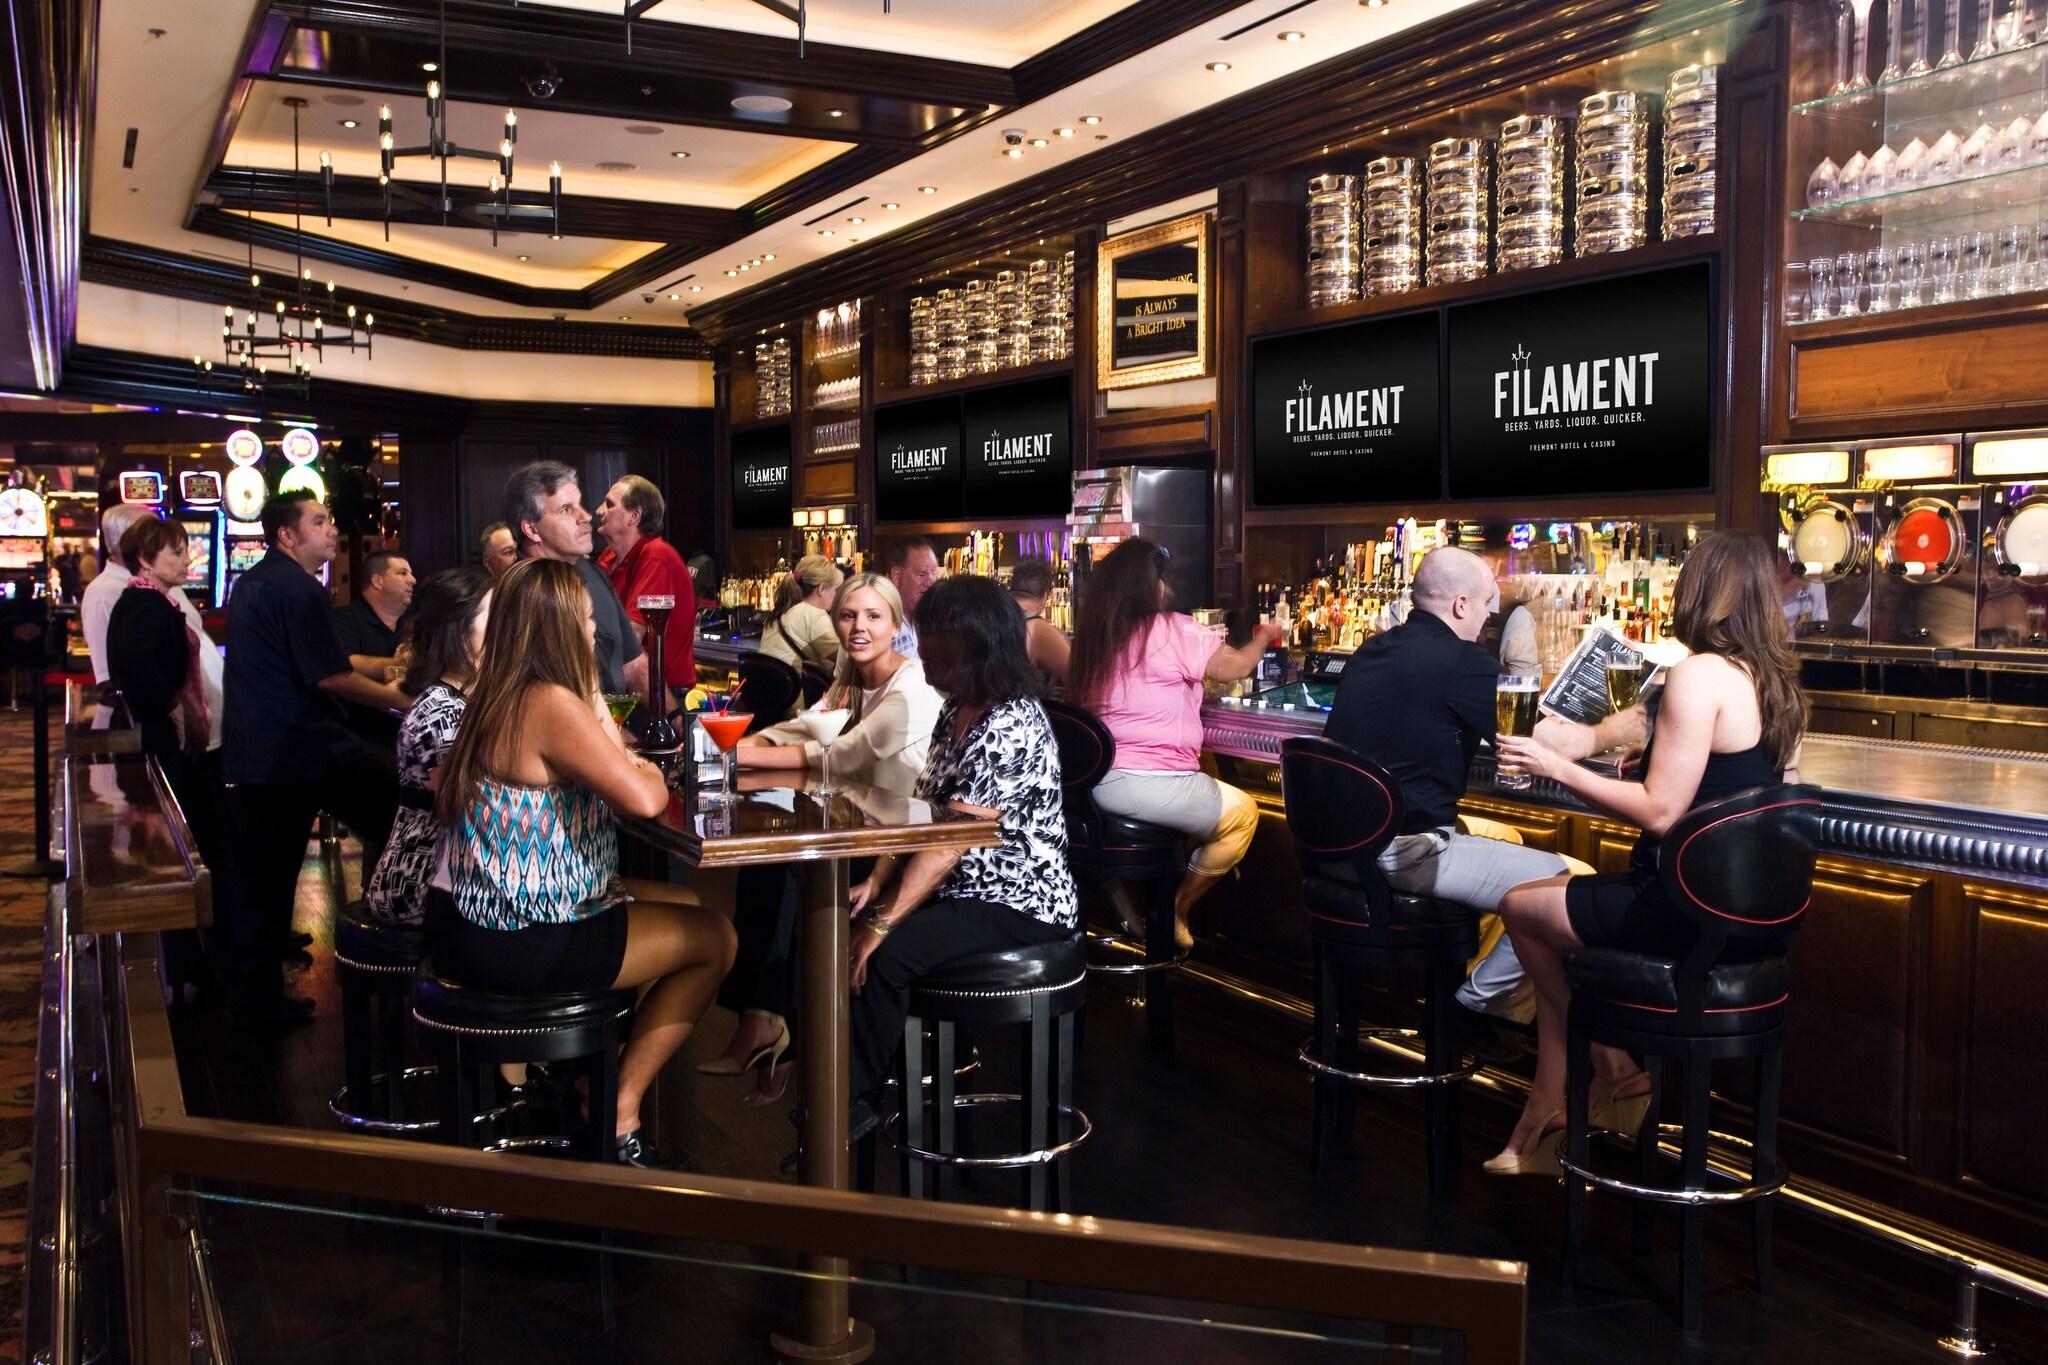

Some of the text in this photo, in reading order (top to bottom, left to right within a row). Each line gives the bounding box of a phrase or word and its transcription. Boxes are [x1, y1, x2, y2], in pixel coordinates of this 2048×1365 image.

[1143, 298, 1177, 315] ALWAYS
[1135, 322, 1164, 337] BRIGHT
[1166, 316, 1186, 330] IDEA
[1494, 352, 1660, 419] FILAMENT
[1285, 385, 1405, 434] FILAMENT
[1504, 411, 1646, 432] BEERS. YARDS. LIQUOR. QUICKER.
[984, 433, 1053, 462] FILAMENT
[1560, 442, 1580, 450] HOTEL
[1590, 440, 1616, 448] CASINO
[892, 447, 948, 470] FILAMENT
[744, 466, 788, 484] FILAMENT
